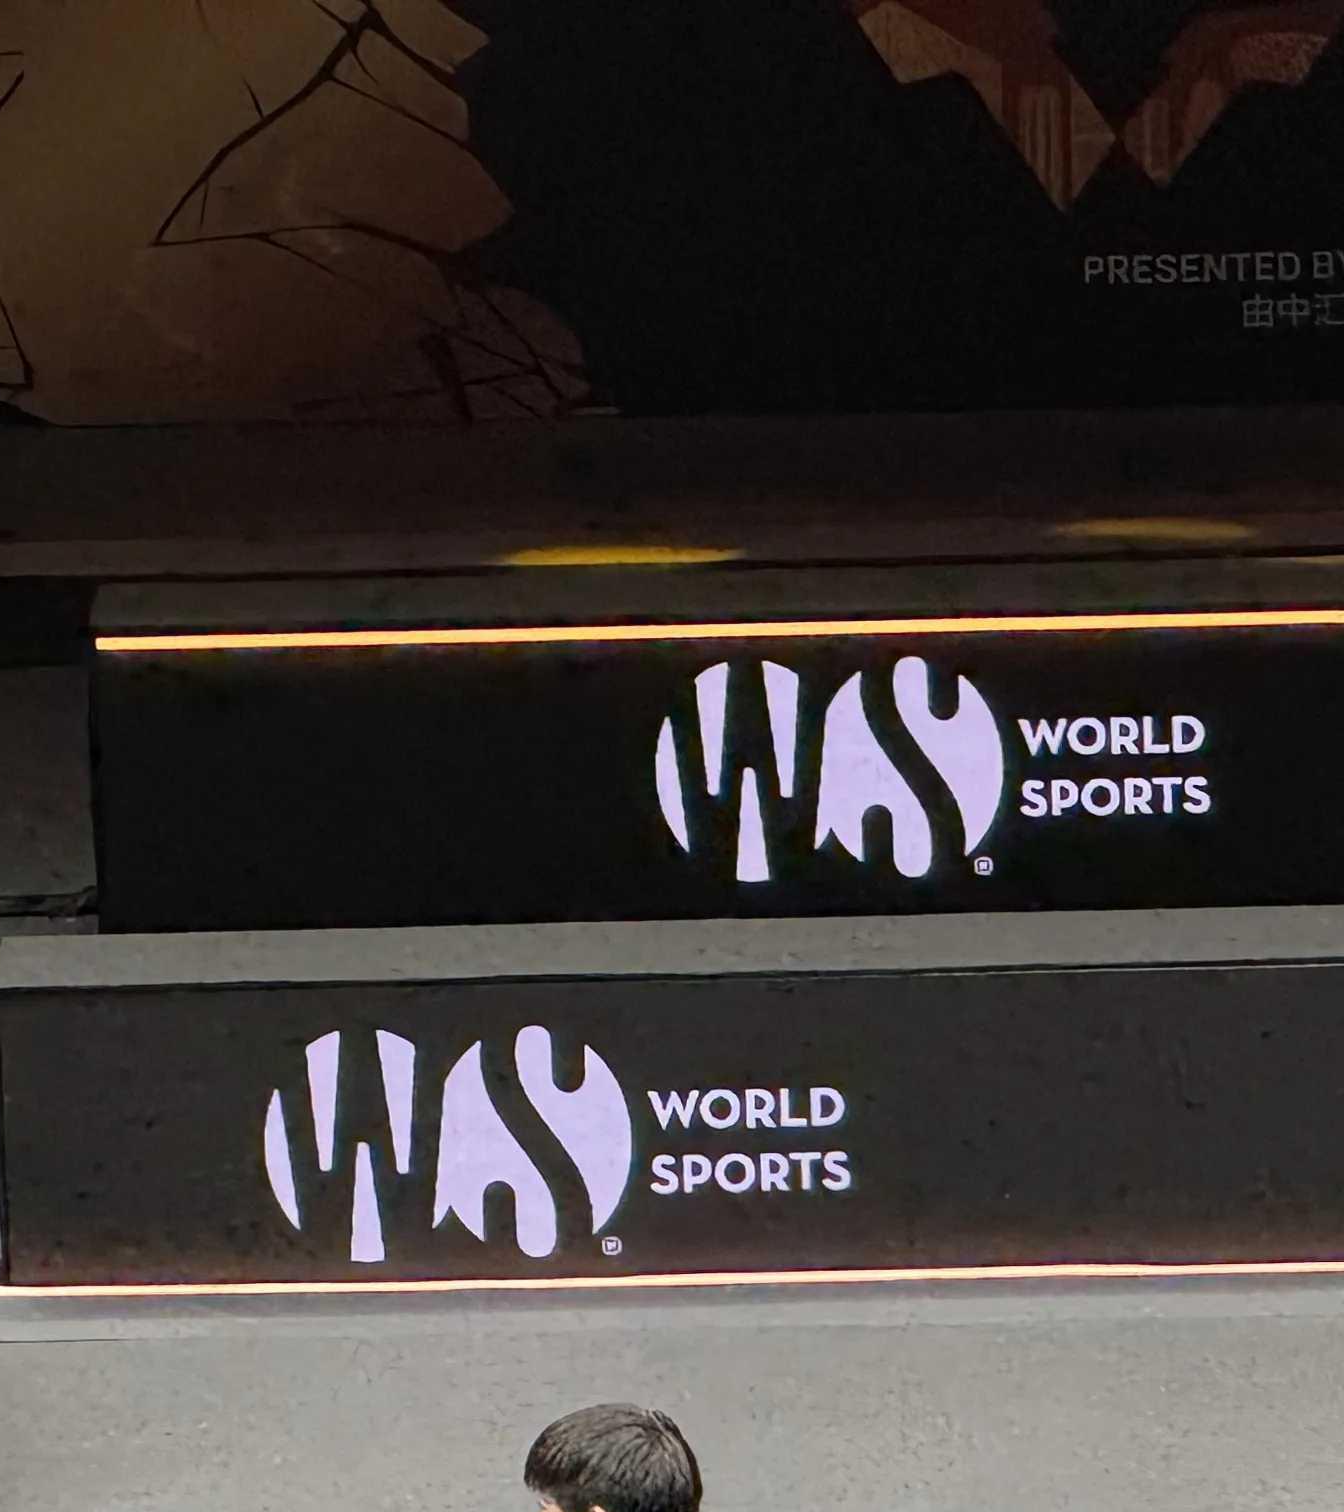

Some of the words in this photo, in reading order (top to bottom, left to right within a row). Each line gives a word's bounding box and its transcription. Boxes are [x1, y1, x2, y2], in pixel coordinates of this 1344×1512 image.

[1082, 252, 1302, 285] PRESENTED
[1017, 715, 1206, 756] WORLD
[1020, 776, 1211, 818] SPORTS
[647, 1087, 846, 1130] WORLD
[650, 1150, 852, 1195] SPORTS
